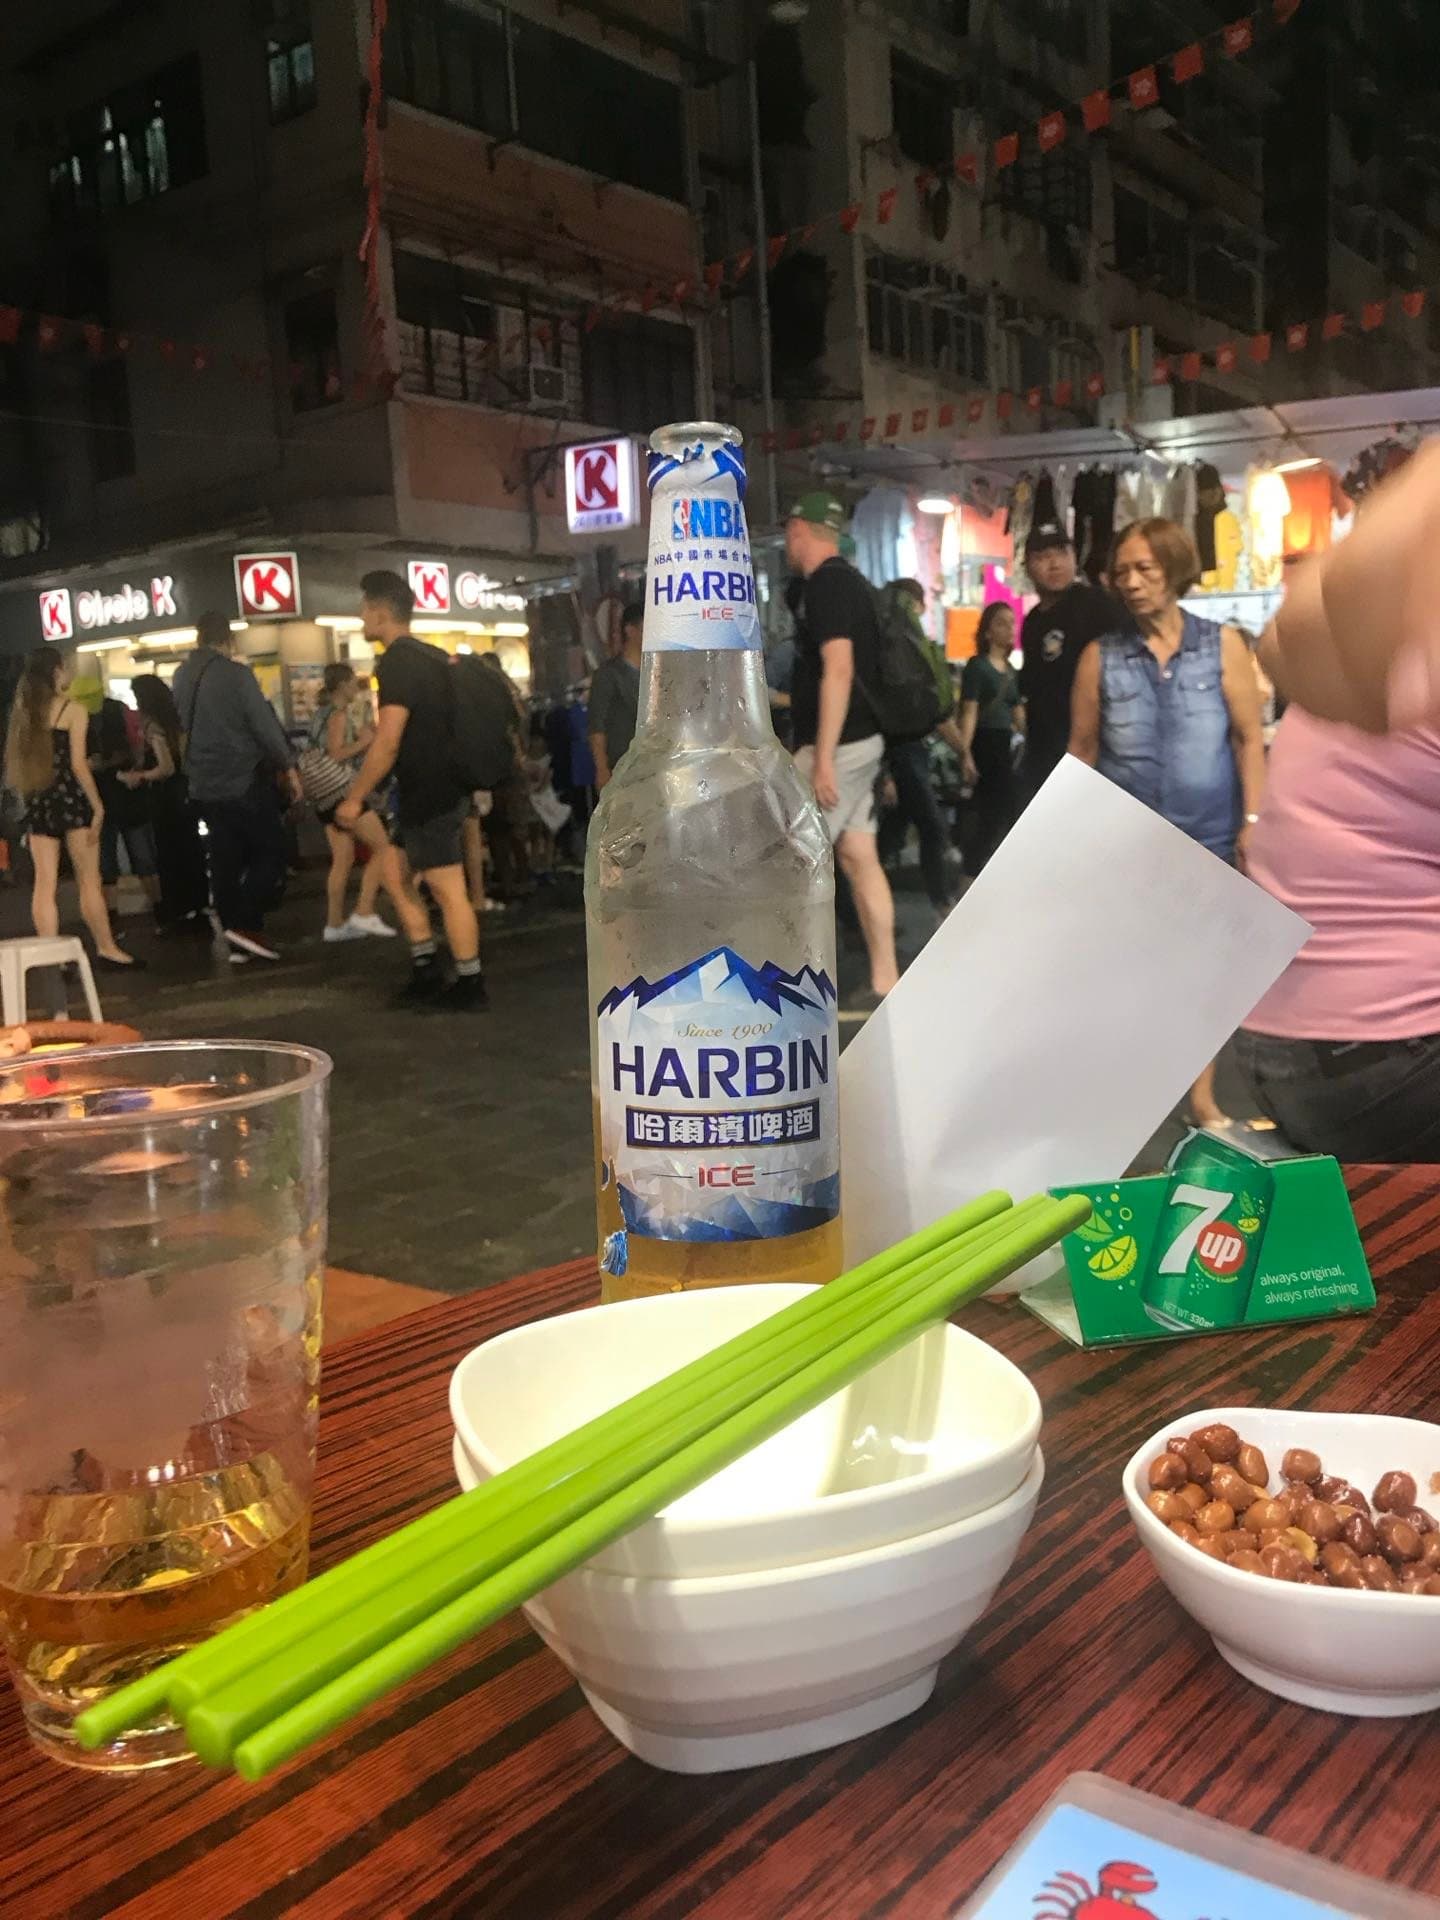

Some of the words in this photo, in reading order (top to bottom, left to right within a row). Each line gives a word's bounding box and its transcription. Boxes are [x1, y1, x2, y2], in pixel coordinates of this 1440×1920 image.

[151, 575, 176, 617] K
[252, 567, 287, 605] K
[702, 606, 735, 621] ICE
[678, 1023, 723, 1038] Since
[732, 1022, 773, 1040] 1900
[612, 1035, 828, 1098] HARBIN
[633, 1106, 813, 1145] 哈爾濱啤酒
[698, 1165, 756, 1188] ICE
[1260, 1272, 1299, 1287] always
[1264, 1291, 1303, 1304] always
[1303, 1282, 1359, 1299] refreshing
